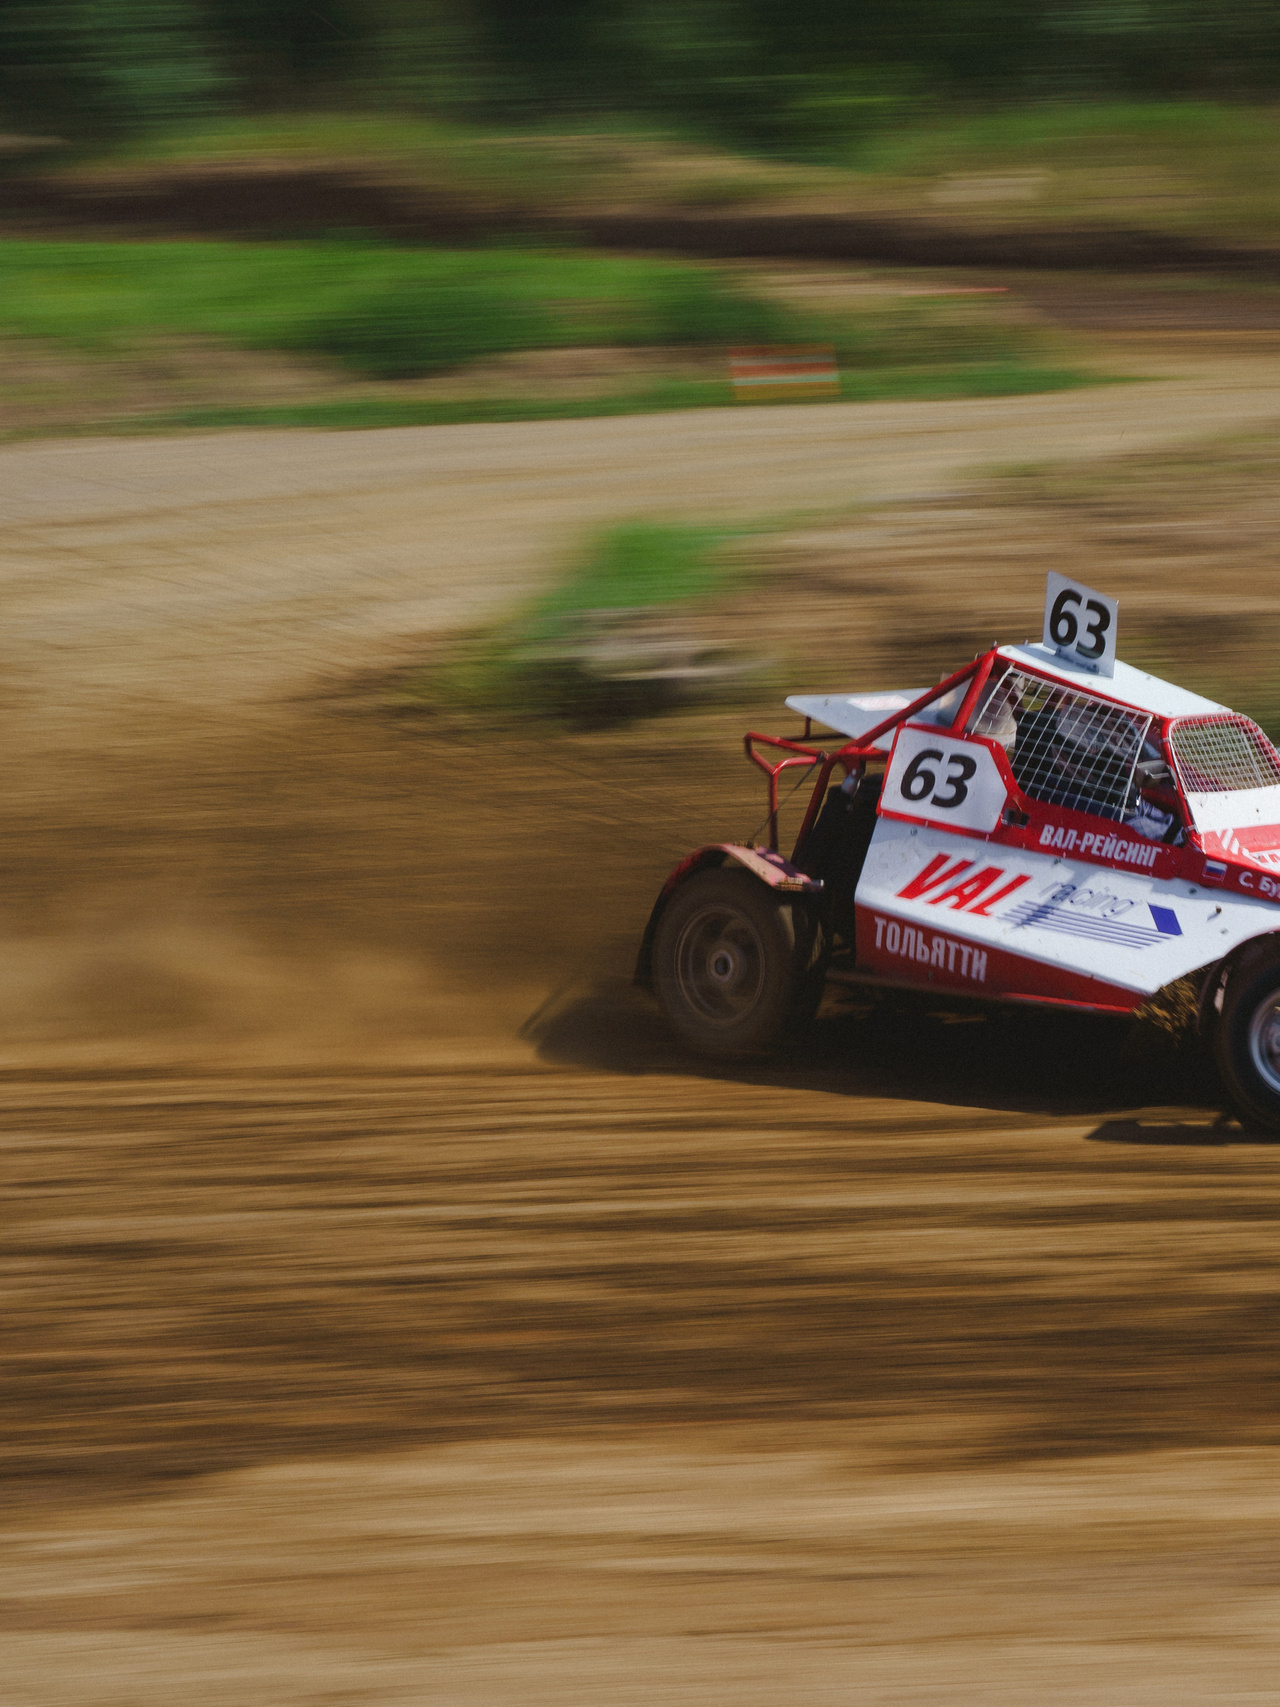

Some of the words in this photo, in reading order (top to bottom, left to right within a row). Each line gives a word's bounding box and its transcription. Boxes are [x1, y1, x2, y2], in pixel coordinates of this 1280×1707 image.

[1050, 589, 1110, 659] 63
[901, 749, 976, 808] 63
[1039, 824, 1162, 867] ВАЛ-РЕЙСИНГ
[895, 853, 1032, 916] VAL
[1039, 881, 1135, 917] racing
[1238, 871, 1254, 889] С.
[874, 916, 988, 983] ТОЛЬЯТТИ
